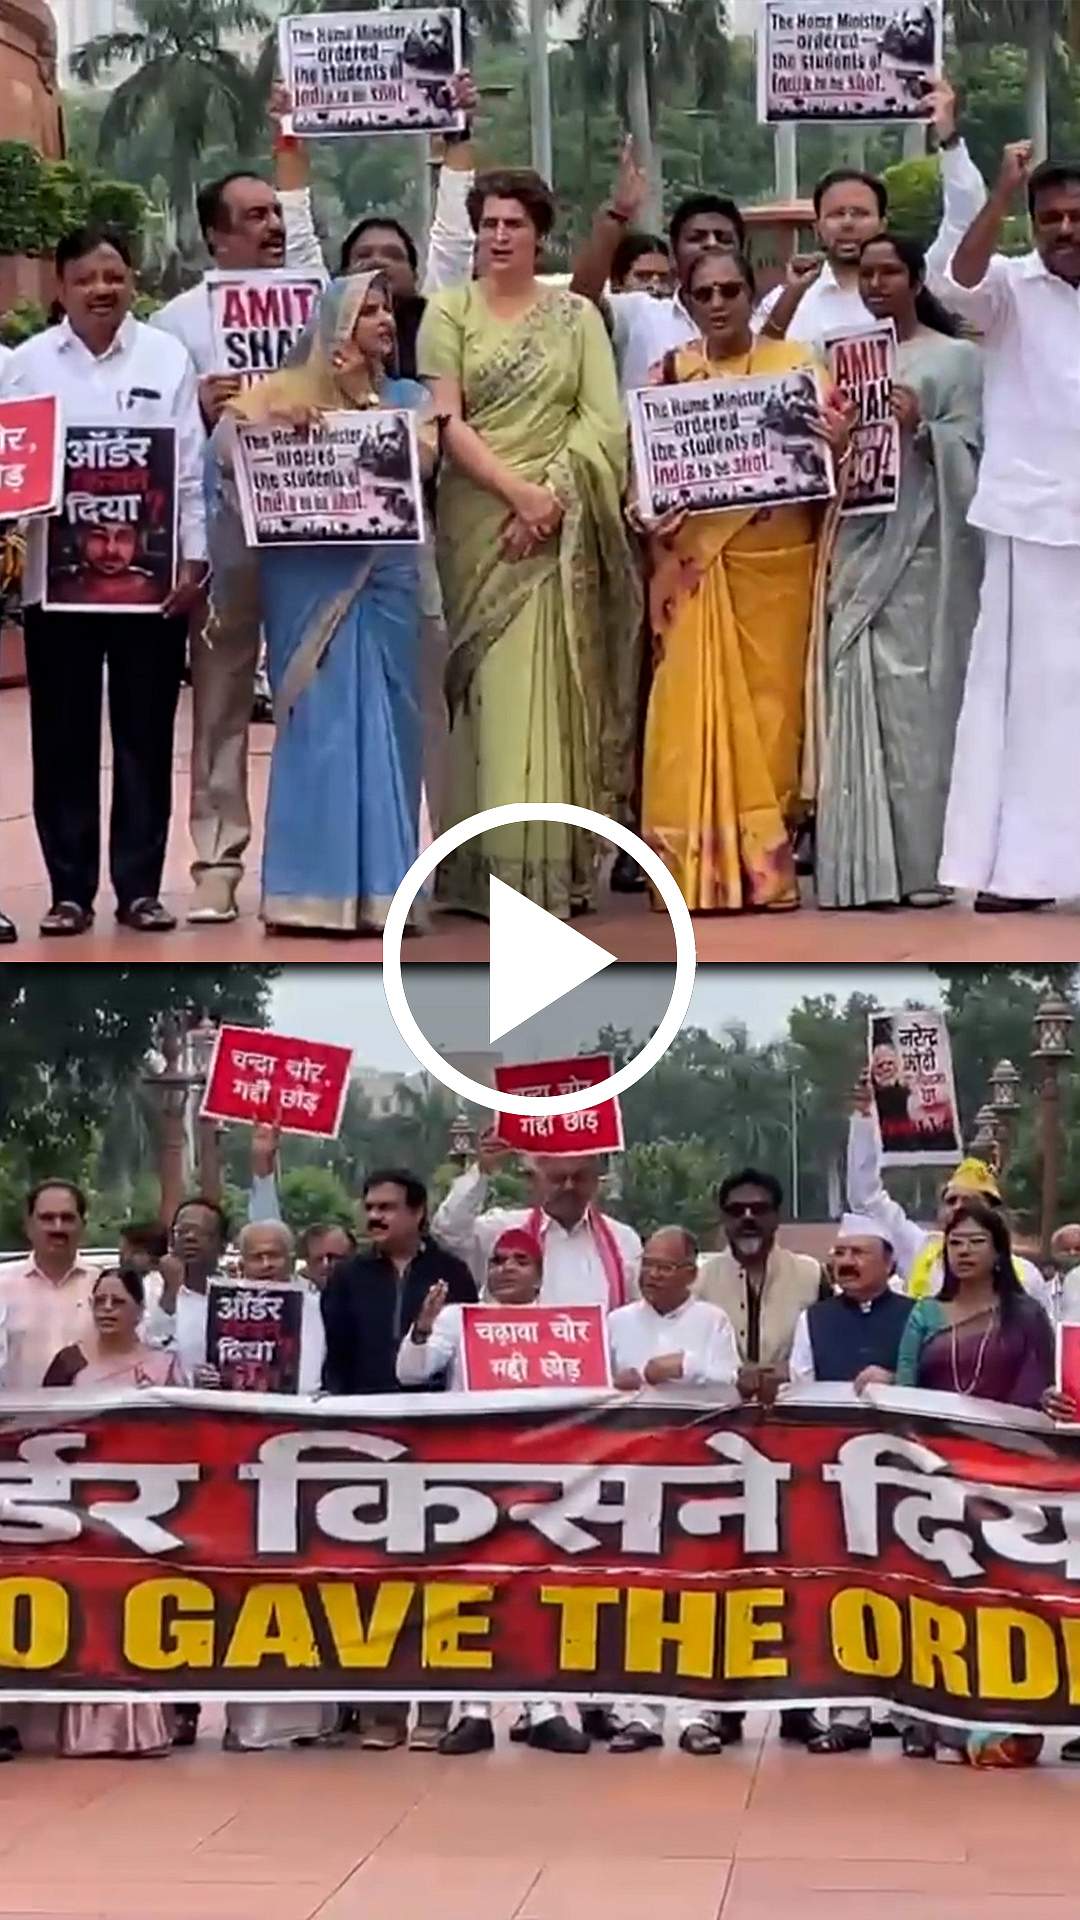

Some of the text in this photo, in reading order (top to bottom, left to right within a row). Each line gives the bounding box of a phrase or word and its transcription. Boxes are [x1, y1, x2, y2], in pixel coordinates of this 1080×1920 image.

[292, 23, 406, 44] The Home Minister
[772, 13, 886, 30] The Home Minister
[317, 43, 379, 63] ordered
[797, 33, 859, 49] ordered
[773, 52, 883, 70] the students of
[294, 65, 318, 85] the
[321, 63, 387, 84] students
[222, 287, 313, 328] AMIT
[225, 329, 303, 369] SHA
[836, 339, 888, 387] AMIT
[644, 390, 765, 420] The Home Minister
[842, 379, 893, 428] HAH
[674, 413, 740, 437] ordered
[67, 430, 152, 469] ऑर्डर
[244, 434, 270, 450] The
[312, 428, 362, 444] Minister
[651, 428, 767, 462] the students of
[276, 448, 335, 467] ordered
[253, 471, 279, 489] the
[284, 469, 346, 488] students
[653, 461, 696, 486] India
[699, 463, 711, 478] to
[715, 461, 730, 476] be
[256, 492, 297, 513] India
[217, 1290, 284, 1320] ऑर्डर
[548, 1313, 592, 1342] चोर
[237, 1430, 791, 1554] किसने
[822, 1432, 1080, 1579] दिय
[123, 1578, 494, 1670] GAVE
[539, 1584, 788, 1679] THE
[831, 1588, 1080, 1705] ORD
